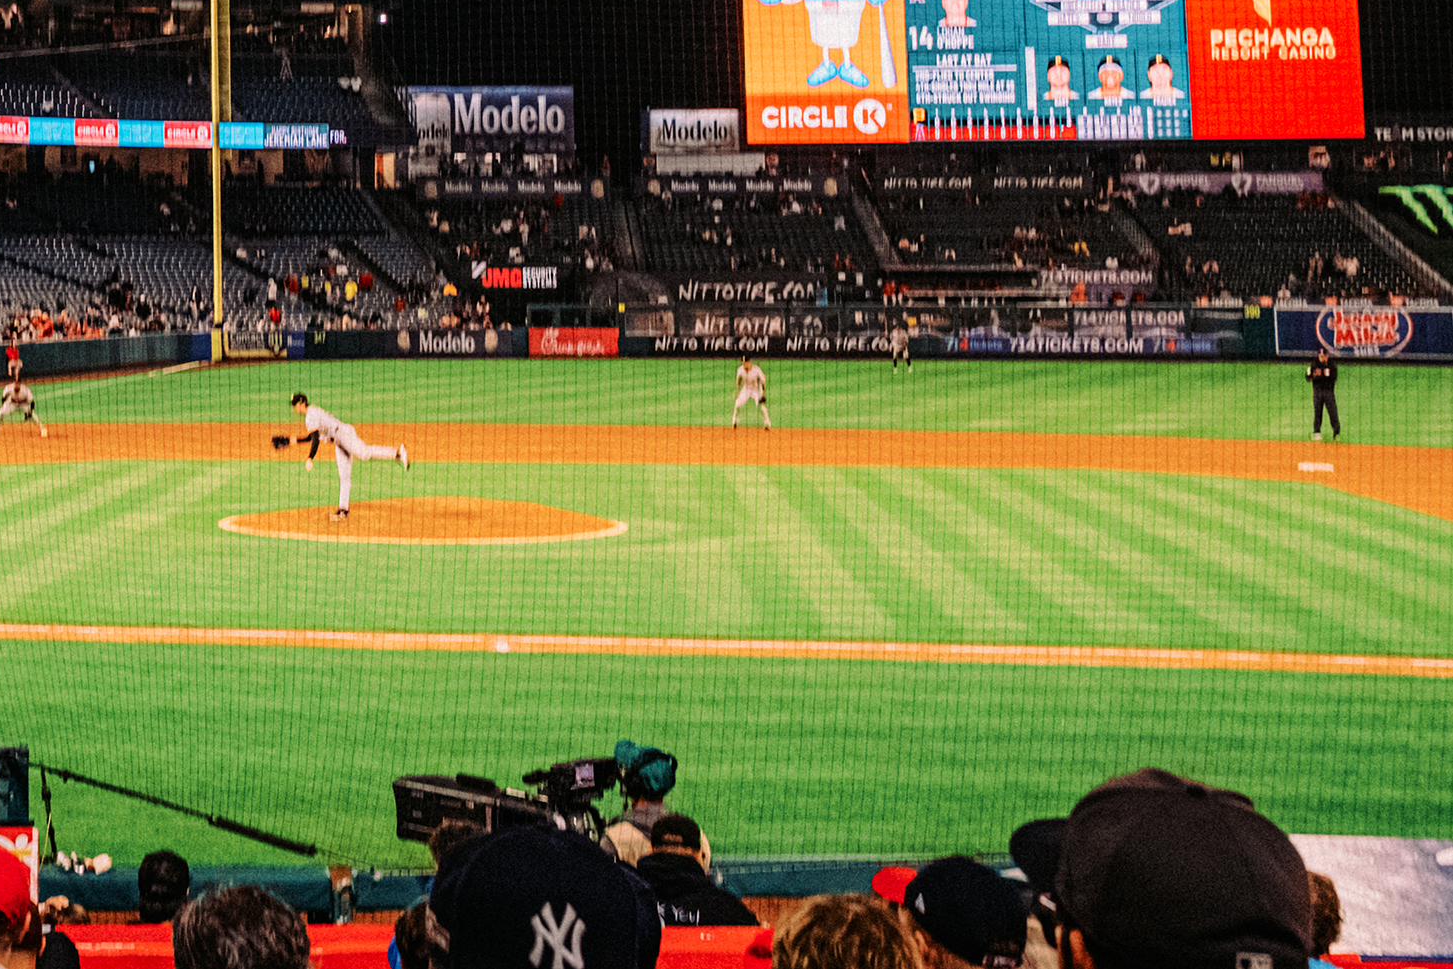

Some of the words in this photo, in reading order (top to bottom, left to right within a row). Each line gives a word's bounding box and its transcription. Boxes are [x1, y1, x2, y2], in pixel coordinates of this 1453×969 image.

[909, 26, 934, 50] 14
[1210, 27, 1334, 48] PECHANGA
[1211, 46, 1270, 60] RESORT
[1278, 46, 1336, 60] CASINO
[454, 93, 566, 133] Modelo
[762, 106, 848, 128] CIRCLE
[854, 98, 886, 134] K
[78, 125, 104, 136] CIRCLE
[168, 127, 196, 139] CIRCLE
[662, 118, 728, 142] Modelo
[1374, 124, 1414, 142] TEAM
[264, 133, 304, 147] JEREMIAH
[306, 133, 327, 147] LANE
[420, 331, 476, 354] Modelo
[654, 334, 698, 352] NITTO
[704, 334, 768, 352] TIRE.COM
[786, 335, 830, 352] NITTO
[836, 336, 892, 352] TIRE.CO
[1010, 338, 1144, 354] 714TICKETS.COM
[528, 902, 586, 969] NY
